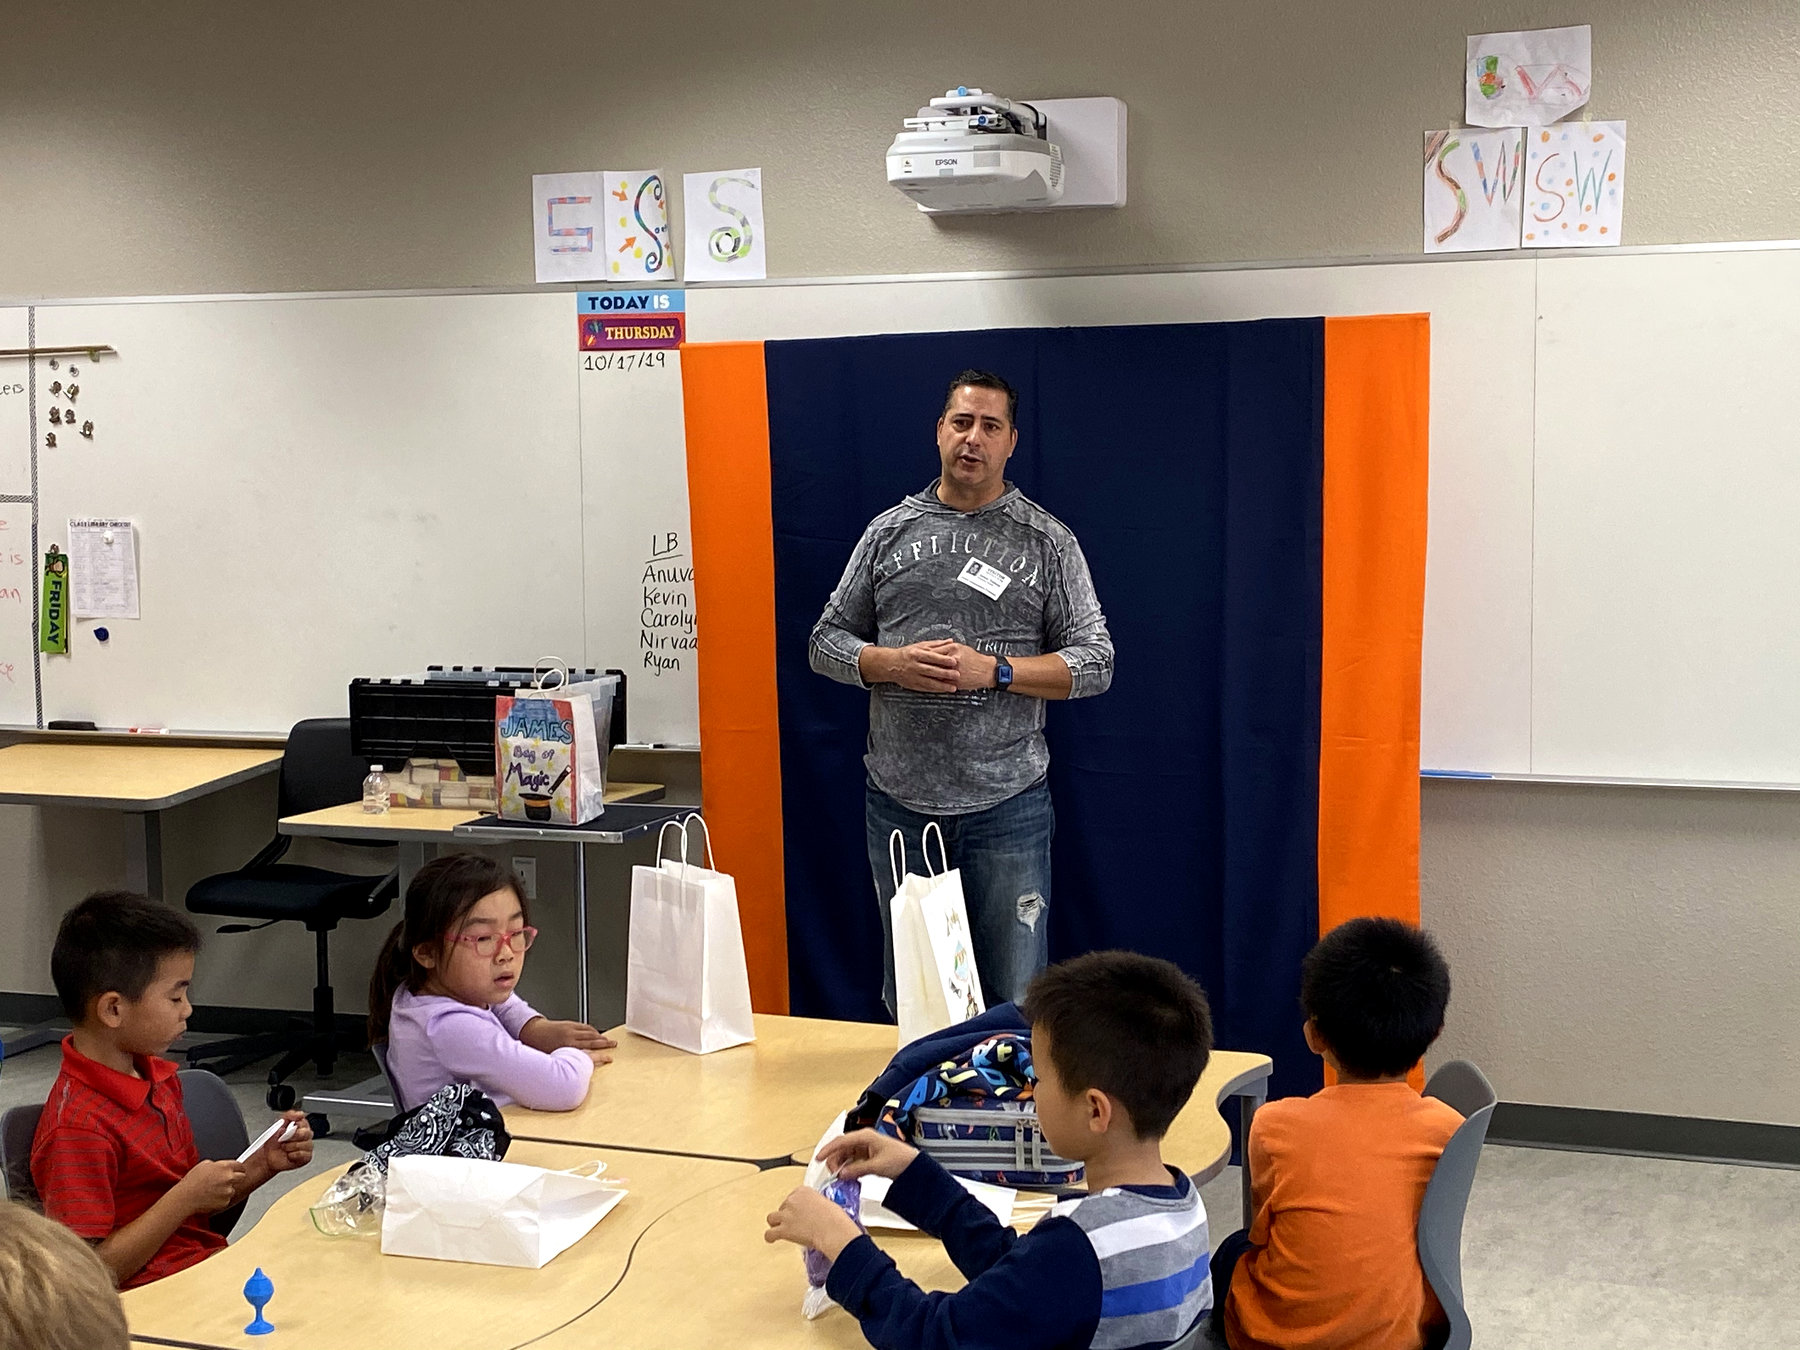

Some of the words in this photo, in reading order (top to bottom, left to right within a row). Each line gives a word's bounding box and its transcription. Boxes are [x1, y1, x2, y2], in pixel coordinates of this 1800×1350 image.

[935, 158, 958, 166] EPSON
[1533, 148, 1613, 222] SW
[587, 295, 650, 311] TODAY
[652, 294, 671, 310] IS
[604, 325, 676, 341] THURSDAY
[583, 351, 666, 372] 10/17/19
[652, 532, 678, 556] LB
[643, 586, 687, 608] Kevin
[46, 580, 62, 645] FRIDAY
[644, 651, 680, 677] Ryan
[501, 715, 574, 745] JAMES
[513, 745, 536, 764] Bag
[505, 761, 550, 792] Magic
